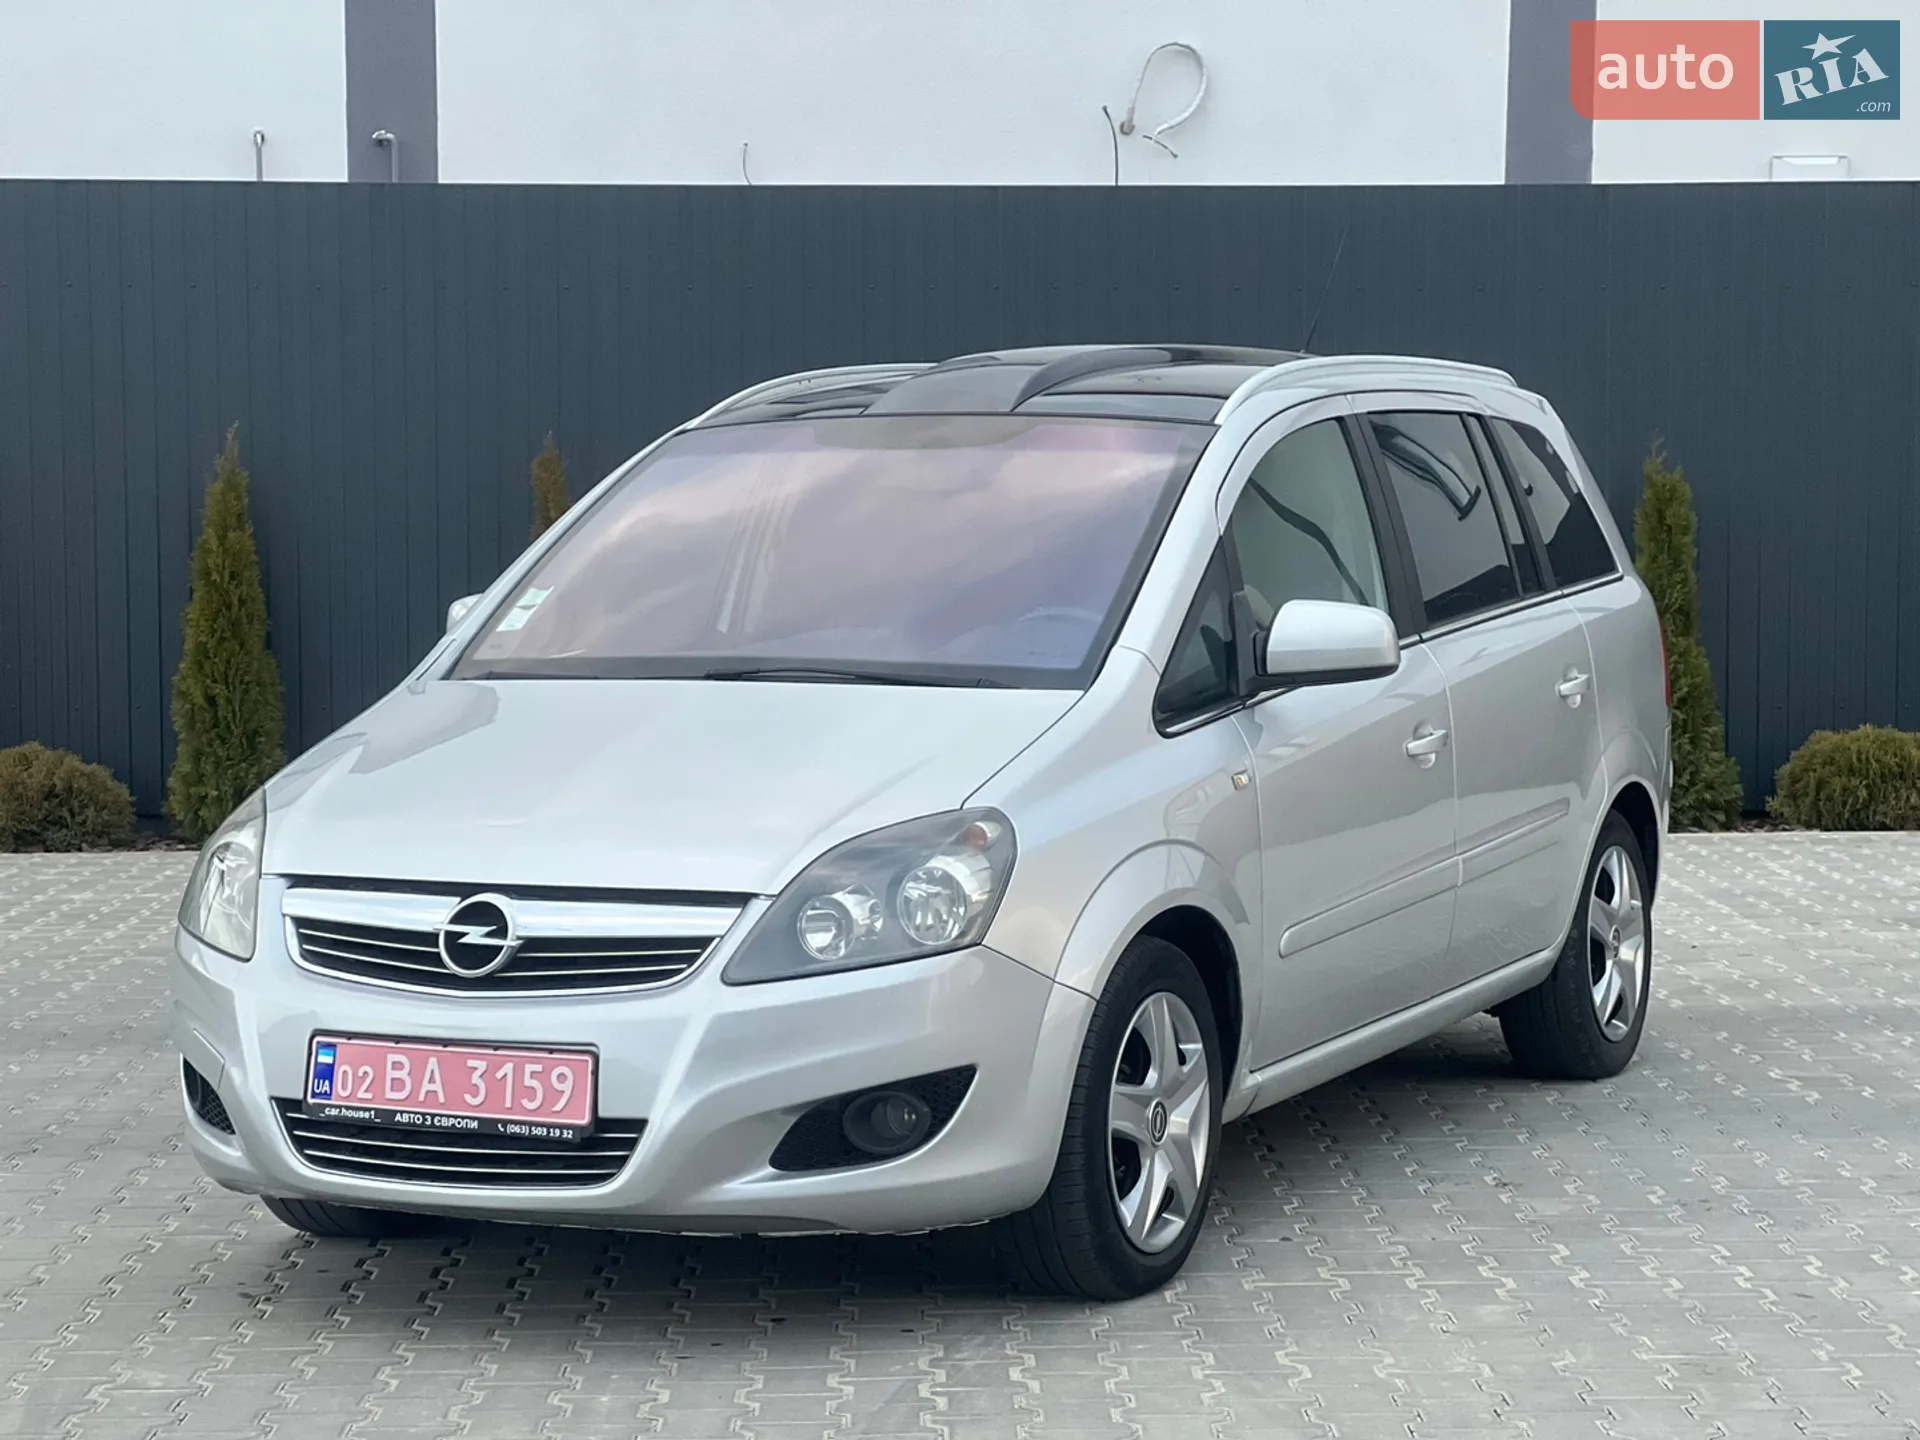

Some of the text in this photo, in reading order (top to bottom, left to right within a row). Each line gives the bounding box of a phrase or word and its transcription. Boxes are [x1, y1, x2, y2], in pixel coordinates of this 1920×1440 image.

[313, 1078, 331, 1095] UA
[337, 1053, 575, 1113] 02 BA 3159
[394, 1112, 423, 1124] АВТО
[433, 1116, 479, 1129] ЄВРОПИ
[506, 1123, 574, 1139] (063) 503 19 32
